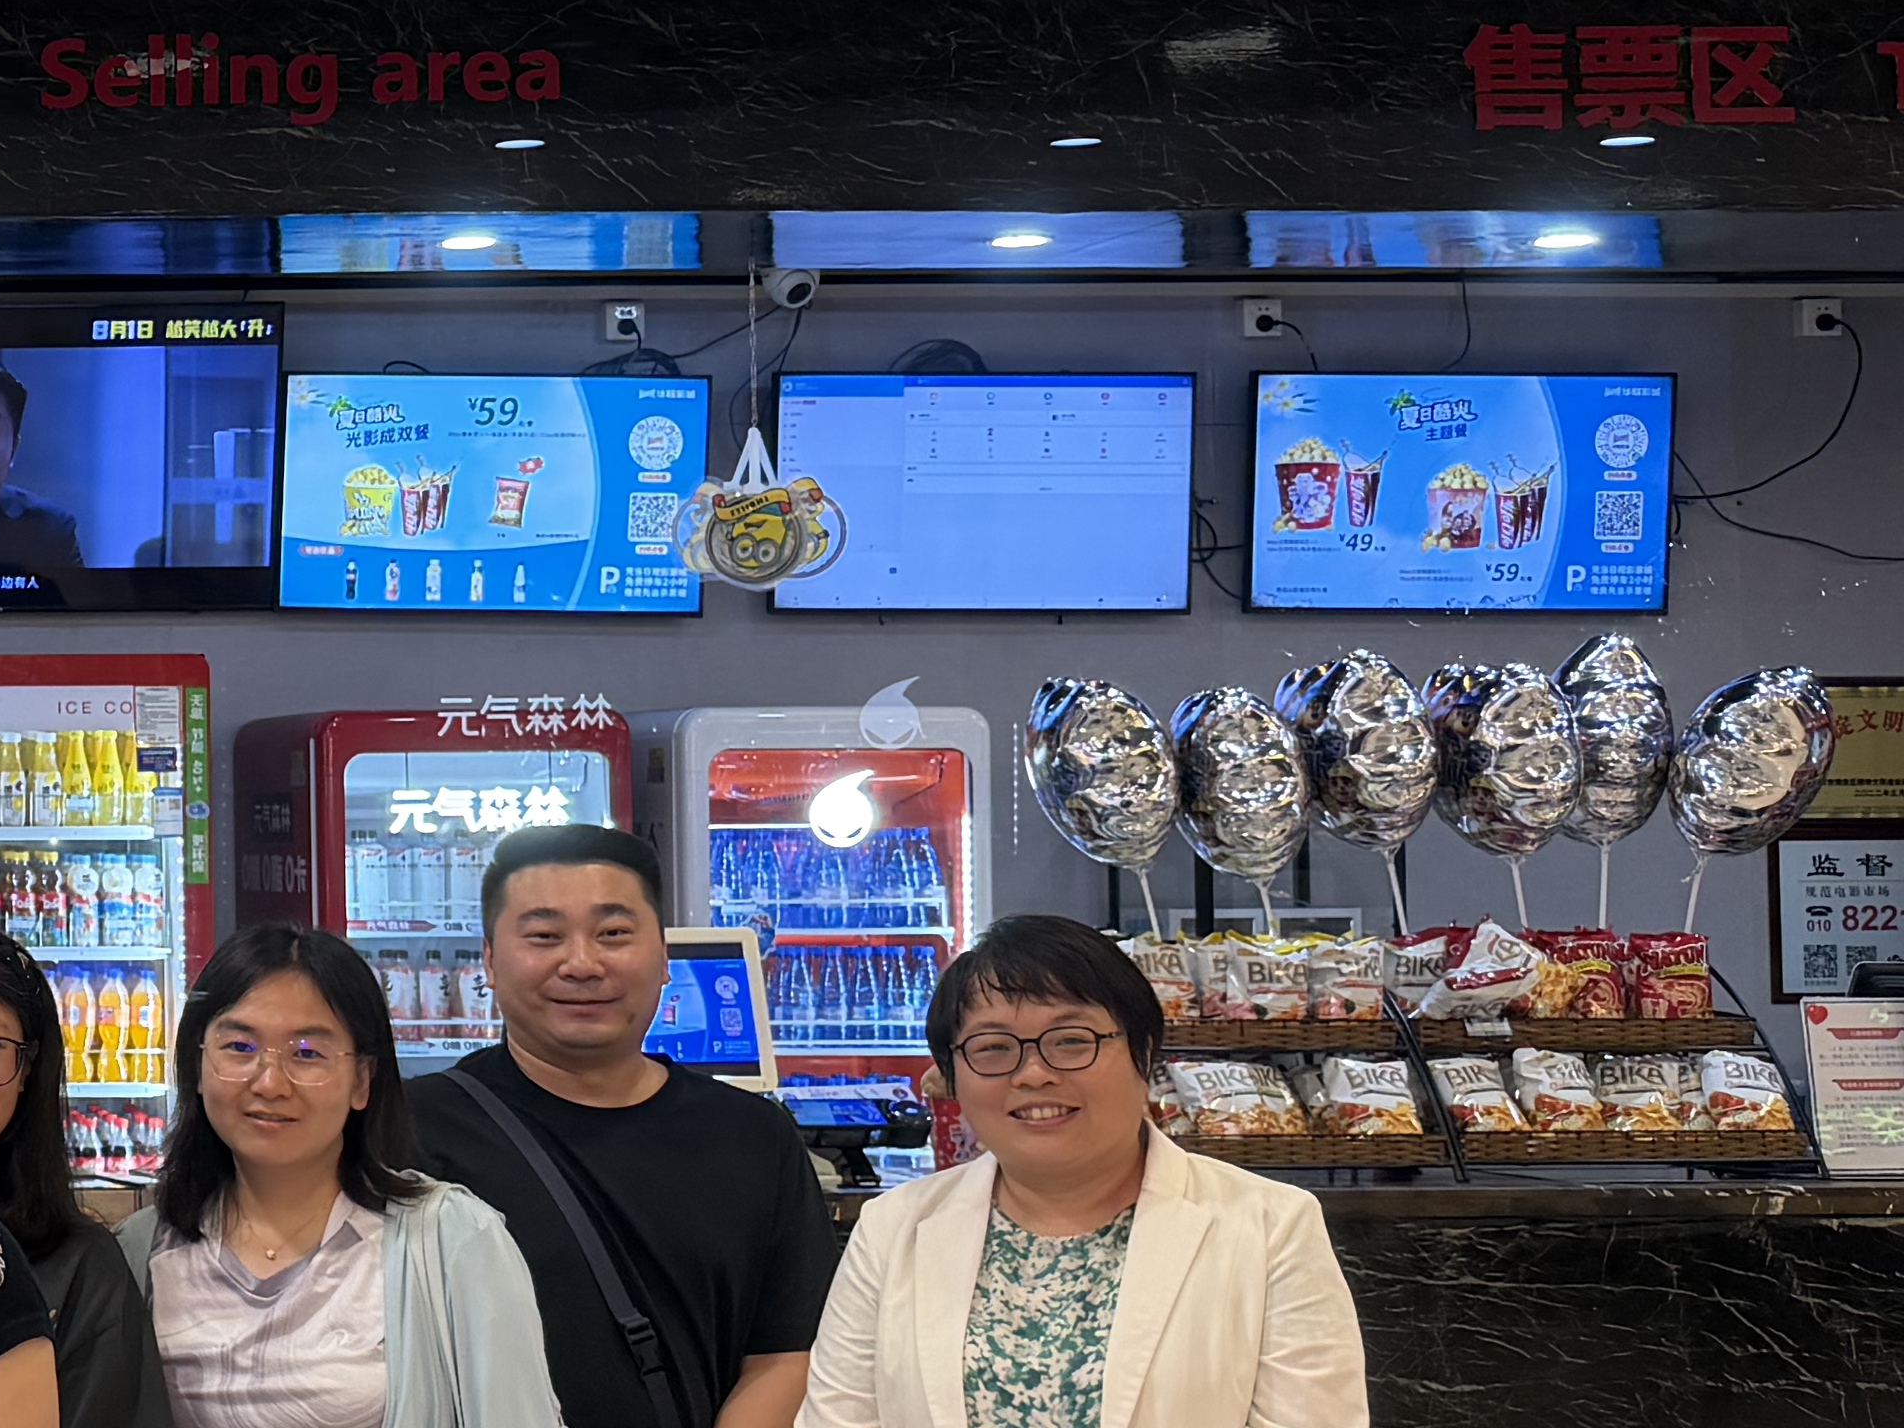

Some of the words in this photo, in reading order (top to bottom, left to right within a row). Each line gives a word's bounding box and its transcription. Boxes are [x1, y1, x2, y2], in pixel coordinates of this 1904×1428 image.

[40, 34, 338, 126] Selling
[372, 49, 561, 103] area
[1463, 23, 1796, 131] 售票区
[92, 320, 154, 340] 8月1日
[468, 397, 519, 426] ¥59
[346, 423, 430, 448] 光影成双餐
[1425, 424, 1467, 442] 主题餐
[1339, 533, 1373, 552] ¥49
[1486, 563, 1519, 582] ¥59
[58, 701, 92, 714] ICE
[104, 701, 133, 714] CO
[437, 693, 613, 737] 元气森林
[389, 785, 570, 834] 元气森林
[285, 854, 307, 894] 0卡
[1807, 853, 1894, 877] 监督
[1806, 885, 1890, 898] 规范电影市场
[1806, 919, 1831, 932] 010
[1842, 905, 1904, 931] 822
[1248, 960, 1309, 984] BIKA
[1395, 954, 1444, 977] BIKA
[1344, 1066, 1408, 1090] BIKA
[1600, 1063, 1667, 1087] BIKA
